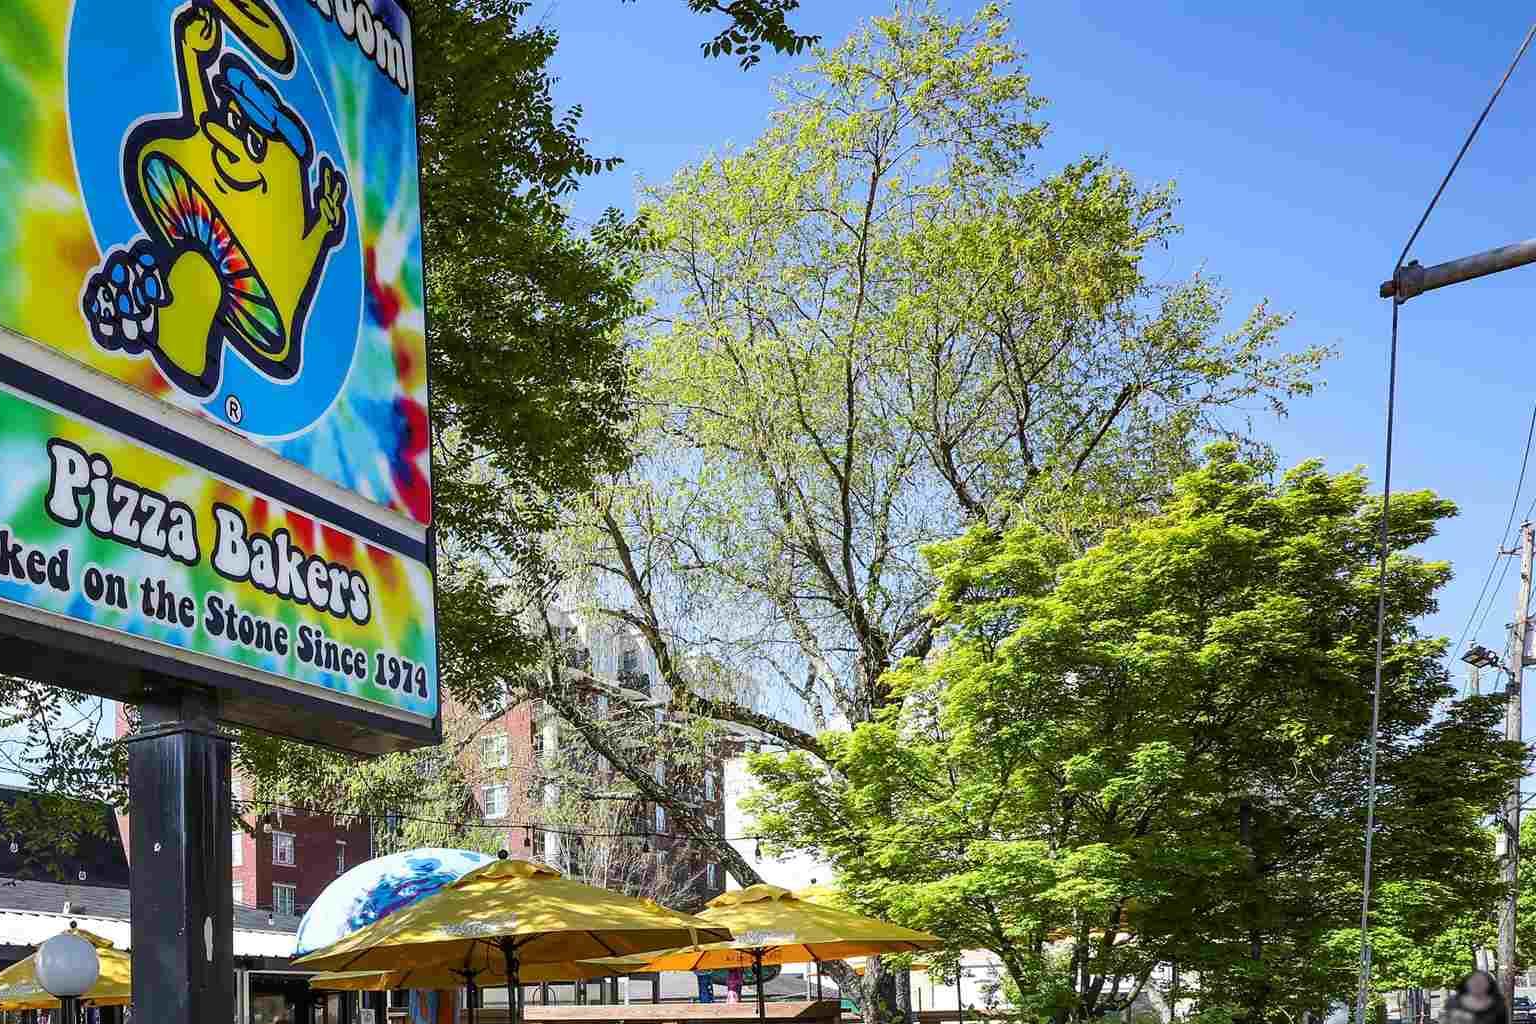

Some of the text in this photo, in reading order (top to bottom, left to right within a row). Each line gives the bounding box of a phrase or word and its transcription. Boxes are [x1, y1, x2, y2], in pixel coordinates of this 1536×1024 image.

[45, 438, 371, 625] Pizza Bakers
[84, 567, 128, 609] on
[140, 577, 195, 628] the
[205, 595, 289, 656] Stone
[297, 625, 367, 679] Since
[375, 653, 428, 699] 1974
